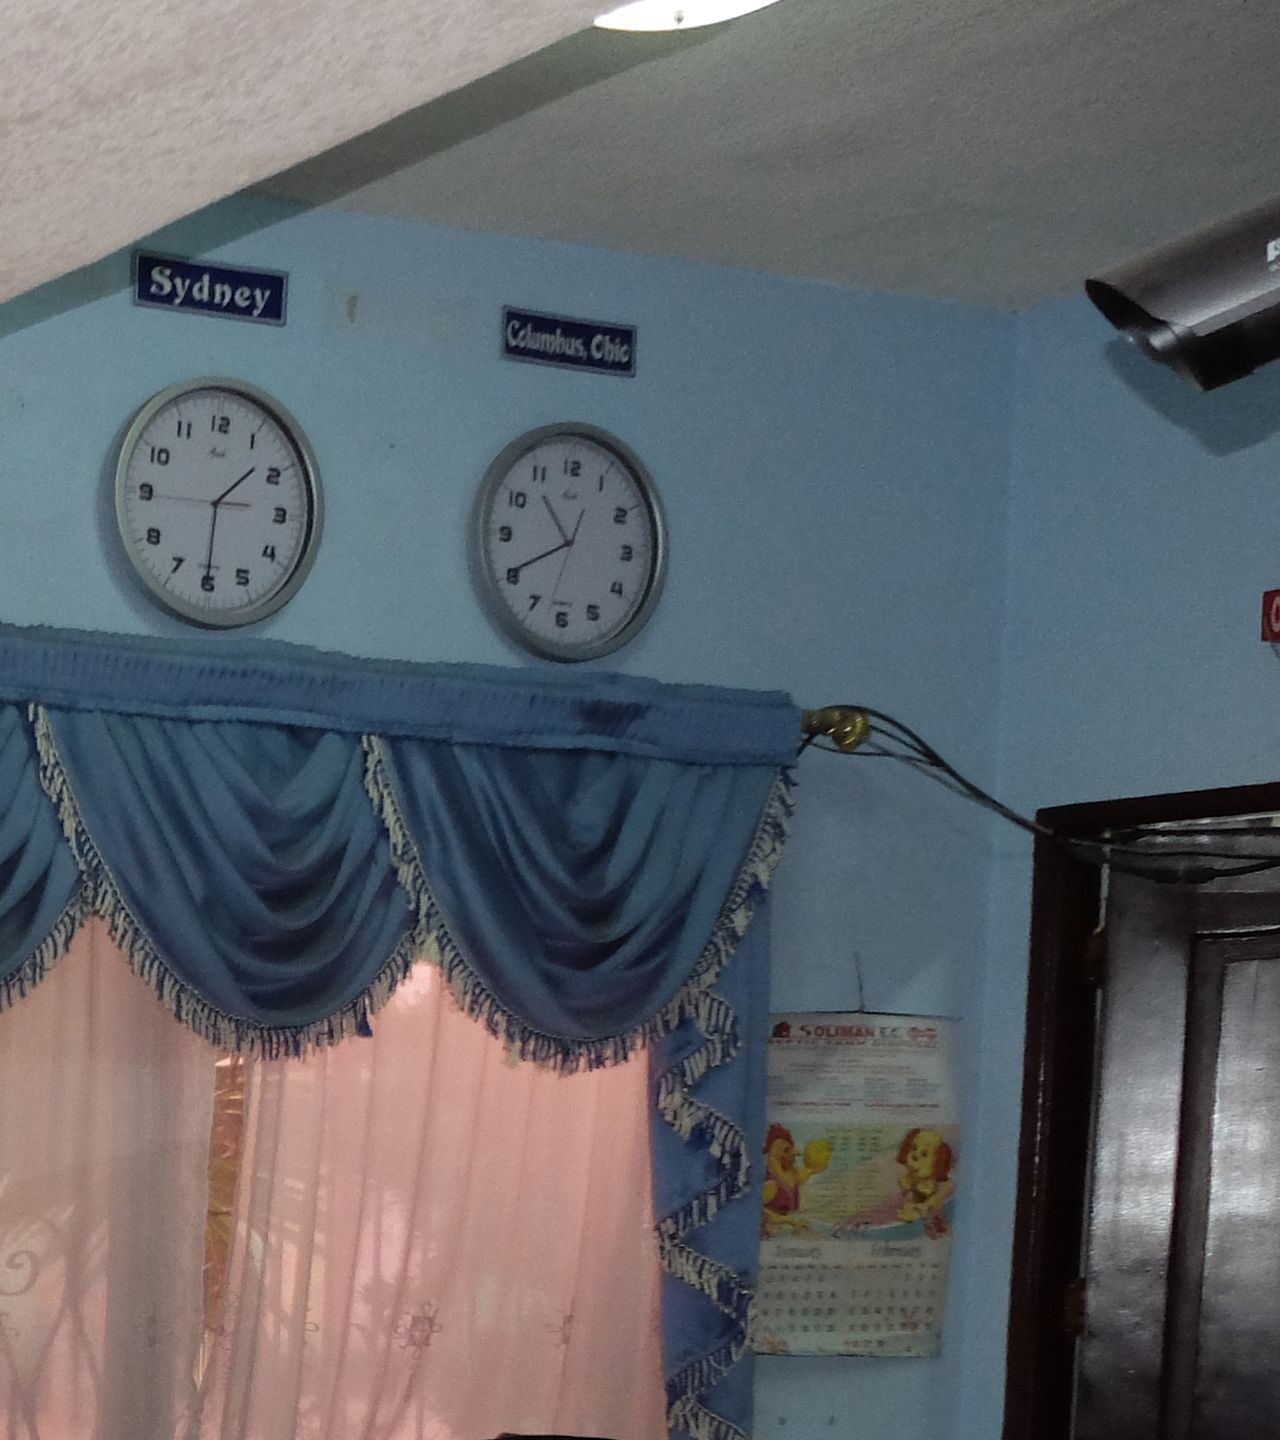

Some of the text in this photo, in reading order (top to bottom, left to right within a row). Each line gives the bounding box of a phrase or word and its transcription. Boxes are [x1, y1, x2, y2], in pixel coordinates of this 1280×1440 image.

[150, 266, 272, 317] Sydney
[177, 420, 191, 439] 11
[210, 415, 230, 434] 12
[150, 446, 170, 465] 10
[266, 467, 281, 485] 2
[532, 465, 547, 483] 11
[563, 458, 581, 477] 12
[139, 483, 153, 501] 9
[509, 491, 526, 508] 10
[272, 507, 287, 524] 3
[146, 528, 161, 545] 8
[499, 526, 512, 542] 9
[262, 545, 276, 562] 4
[171, 557, 185, 574] 7
[201, 574, 215, 592] 6
[235, 568, 250, 586] 5
[506, 567, 520, 585] 8
[610, 581, 623, 597] 4
[528, 594, 542, 611] 7
[555, 611, 569, 628] 6
